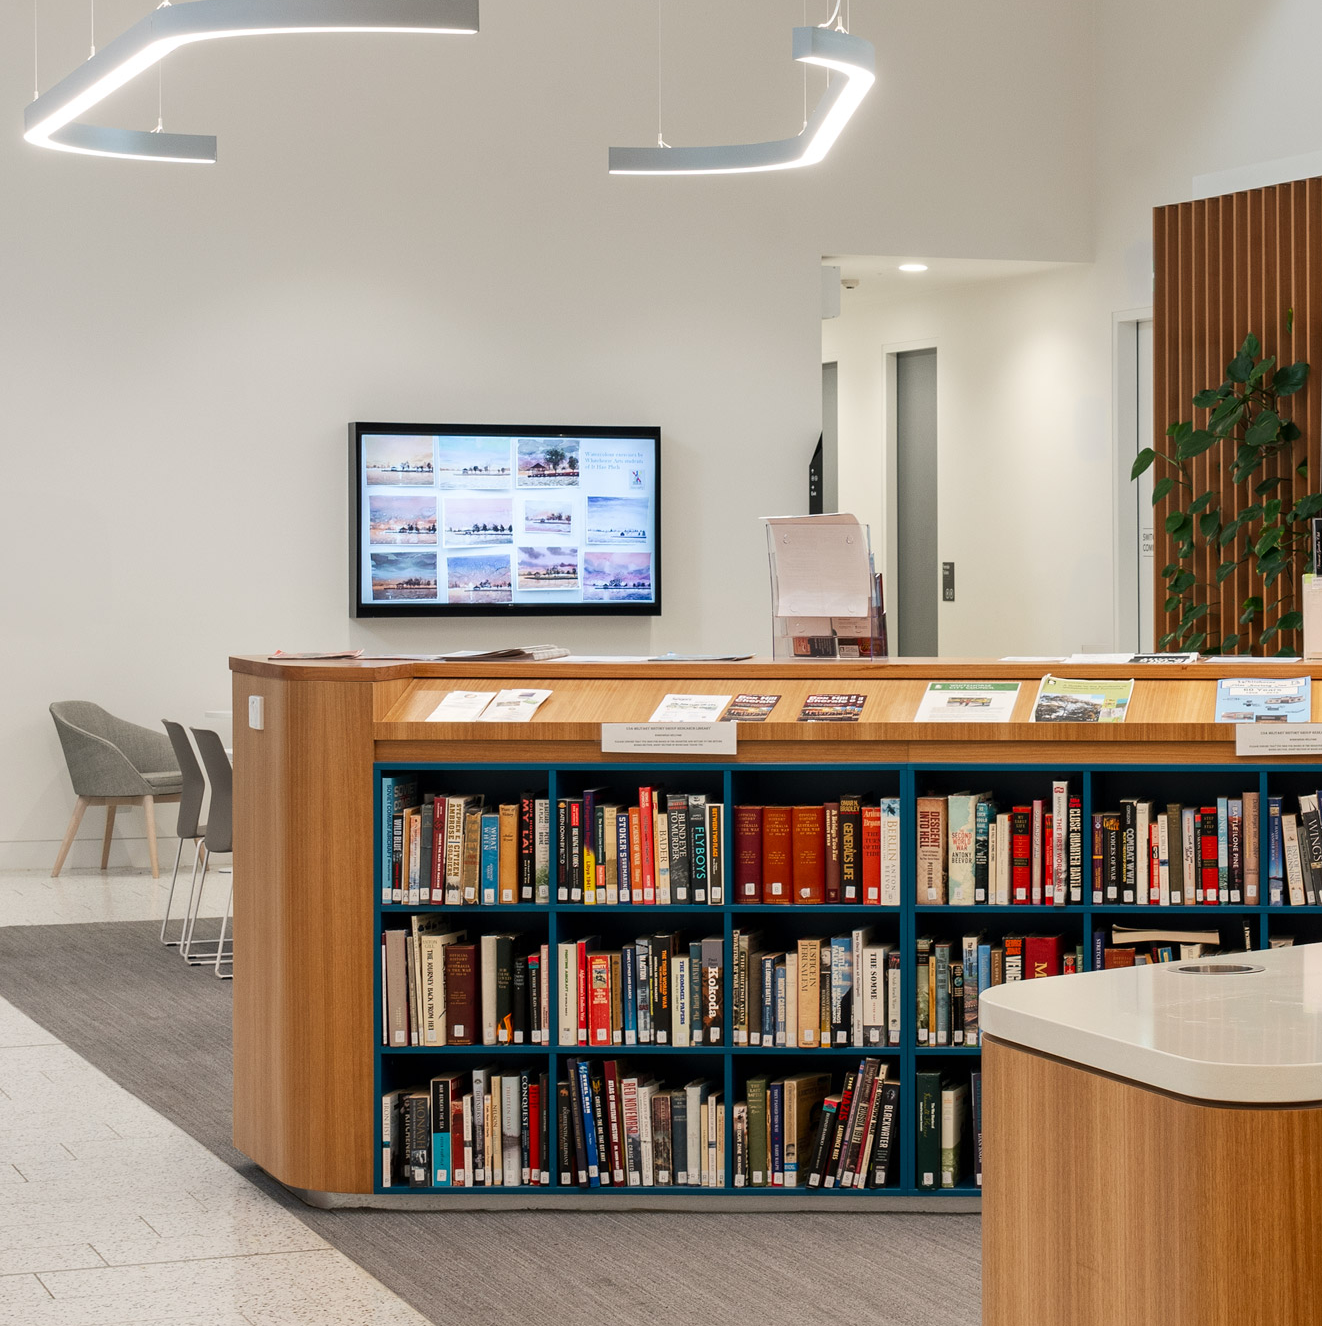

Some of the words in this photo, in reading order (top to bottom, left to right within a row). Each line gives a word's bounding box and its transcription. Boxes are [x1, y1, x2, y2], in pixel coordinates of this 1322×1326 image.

[394, 819, 402, 835] WILD
[522, 799, 529, 823] MY
[671, 811, 678, 823] TO
[920, 811, 930, 829] INTO
[1069, 808, 1081, 832] CLOSE
[394, 836, 402, 851] BLUE
[672, 824, 680, 861] MURDER
[843, 823, 857, 863] GENERAL'S
[887, 820, 898, 861] BERLIN
[920, 831, 930, 849] HELL
[930, 811, 940, 849] DESCENT
[1126, 828, 1135, 861] COMBAT
[1308, 819, 1322, 862] WINGS
[695, 827, 706, 879] FLYBOYS
[1069, 833, 1081, 866] QUARTER
[1287, 845, 1295, 885] BEGINNING
[843, 864, 854, 880] LIFE
[1126, 862, 1135, 884] WWII
[1005, 939, 1022, 947] GEORGE
[800, 942, 808, 992] JERUSALEM
[708, 966, 719, 1018] Kokoda
[623, 1082, 636, 1096] RED
[624, 1098, 639, 1134] NOVEMBER
[838, 1090, 853, 1121] NAZIS
[856, 1105, 868, 1128] RUSSIA
[416, 1099, 426, 1149] MONASH
[611, 1123, 619, 1143] HISTORY
[879, 1105, 893, 1149] BLACKWATER
